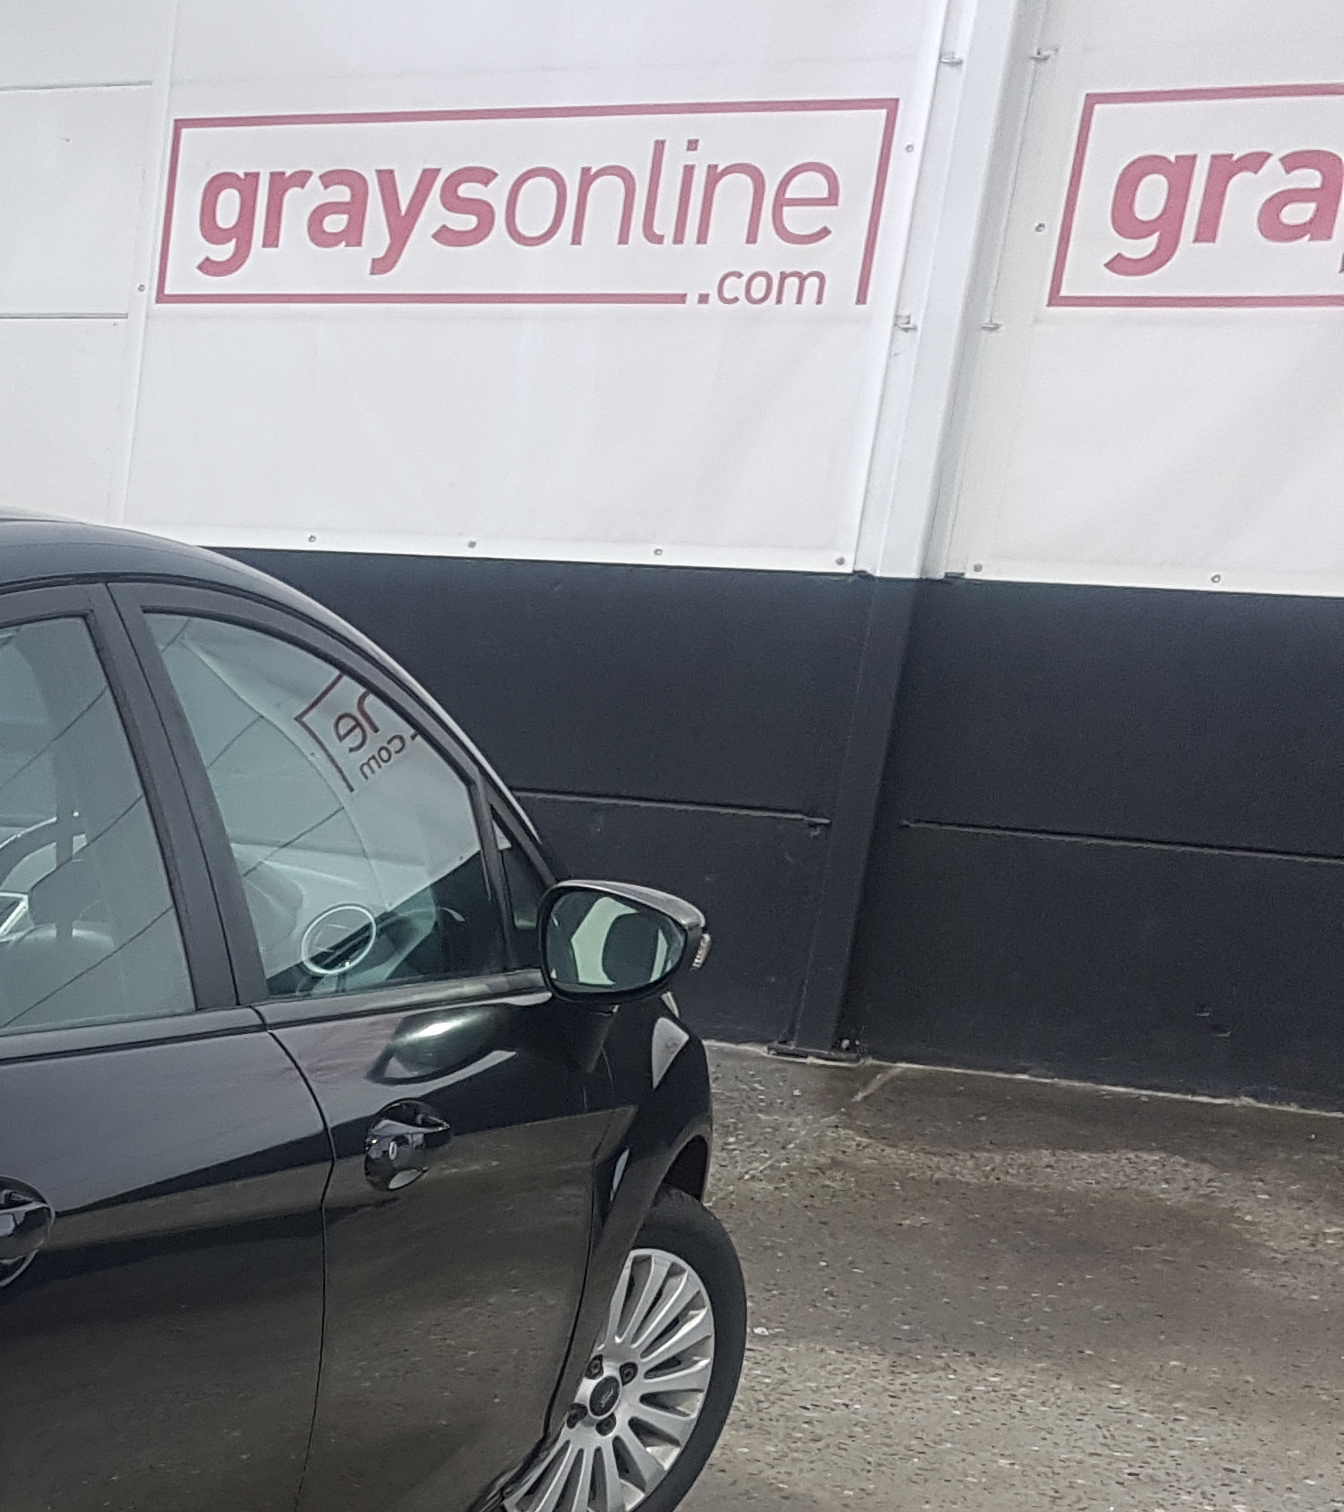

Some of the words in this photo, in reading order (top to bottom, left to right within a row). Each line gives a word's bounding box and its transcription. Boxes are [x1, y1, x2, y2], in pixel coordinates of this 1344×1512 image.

[197, 140, 839, 277] graysonline
[1104, 149, 1344, 277] gra
[700, 271, 826, 305] .com
